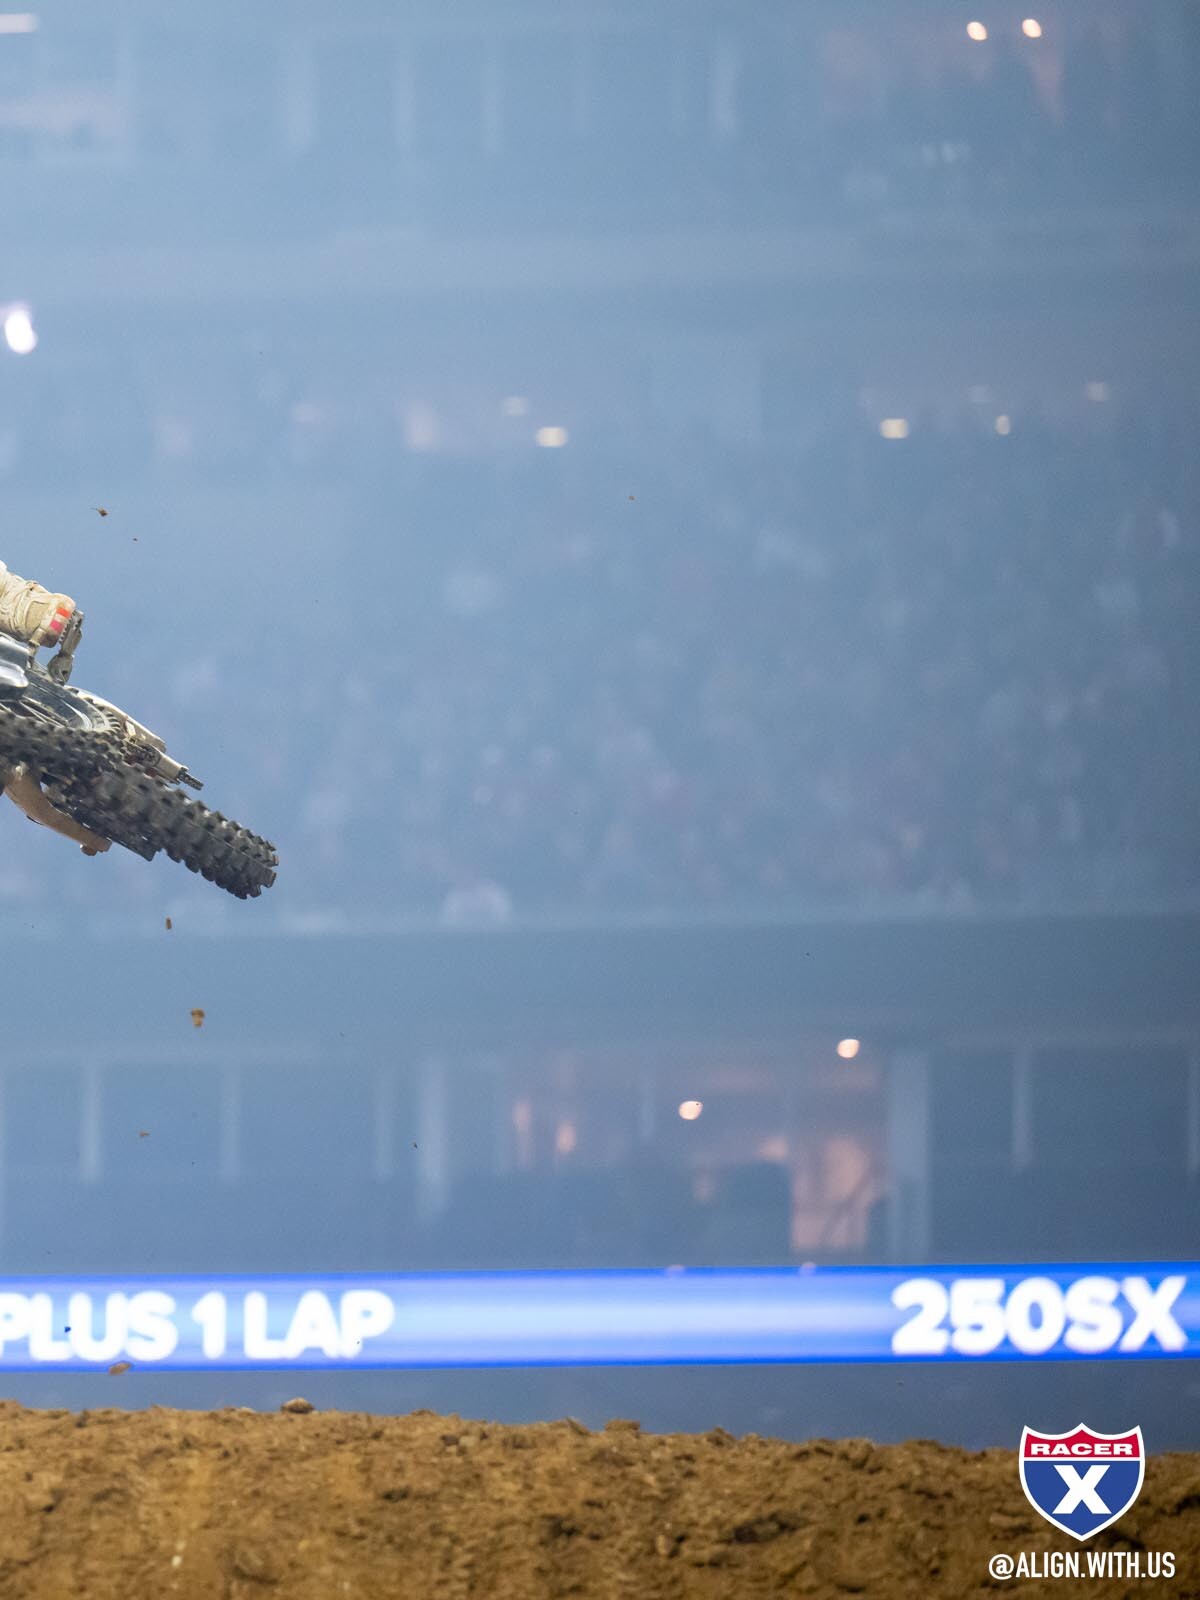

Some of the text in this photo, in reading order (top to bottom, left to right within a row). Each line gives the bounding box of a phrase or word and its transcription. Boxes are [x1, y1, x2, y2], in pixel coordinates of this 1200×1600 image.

[190, 1290, 228, 1360] 1
[243, 1288, 396, 1360] LAP
[890, 1274, 1189, 1356] 250SX
